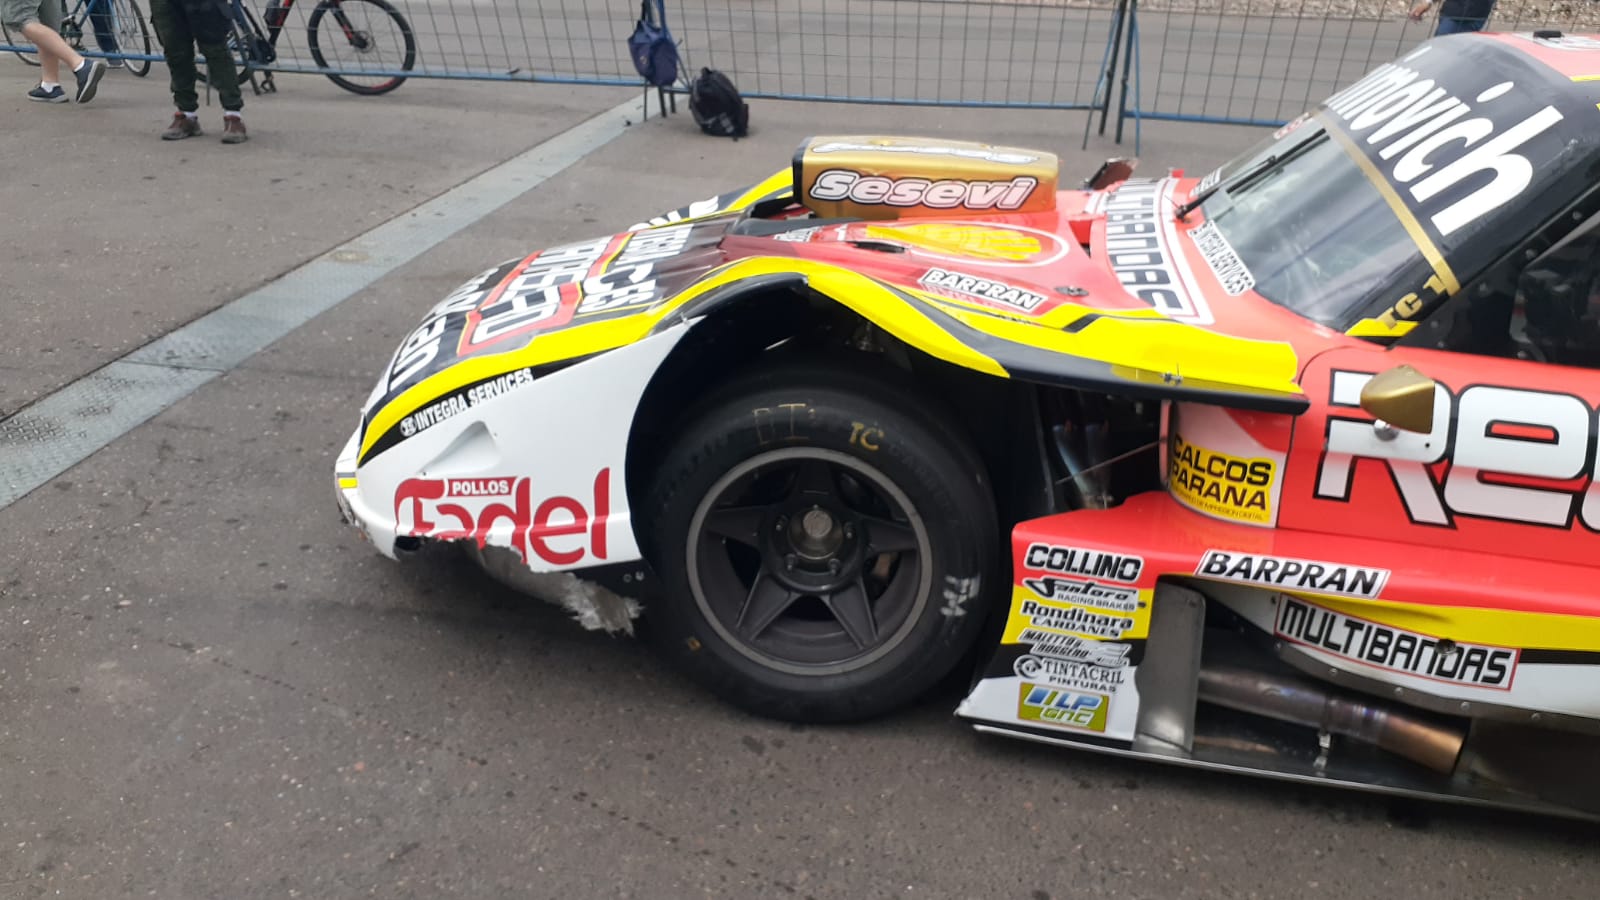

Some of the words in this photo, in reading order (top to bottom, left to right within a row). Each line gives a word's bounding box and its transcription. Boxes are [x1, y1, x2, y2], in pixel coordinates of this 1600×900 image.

[809, 168, 1037, 209] Sesevi
[923, 269, 1043, 310] BARPRAN
[1375, 292, 1423, 330] TC
[416, 393, 469, 431] INTEGRA
[467, 368, 533, 408] SERVICES
[849, 421, 884, 451] TC
[1313, 368, 1600, 535] Re
[1173, 434, 1271, 487] CALCOS
[452, 480, 509, 496] POLLOS
[1026, 545, 1142, 581] COLLINO
[1202, 553, 1379, 597] BARPRAN
[1024, 577, 1137, 600] Santoro
[1058, 594, 1091, 606] RACING
[1022, 601, 1133, 629] Rondinara
[1278, 601, 1513, 686] MULTIBANDAS
[1043, 660, 1125, 684] TINTACRIL
[1048, 675, 1118, 693] PINTURAS
